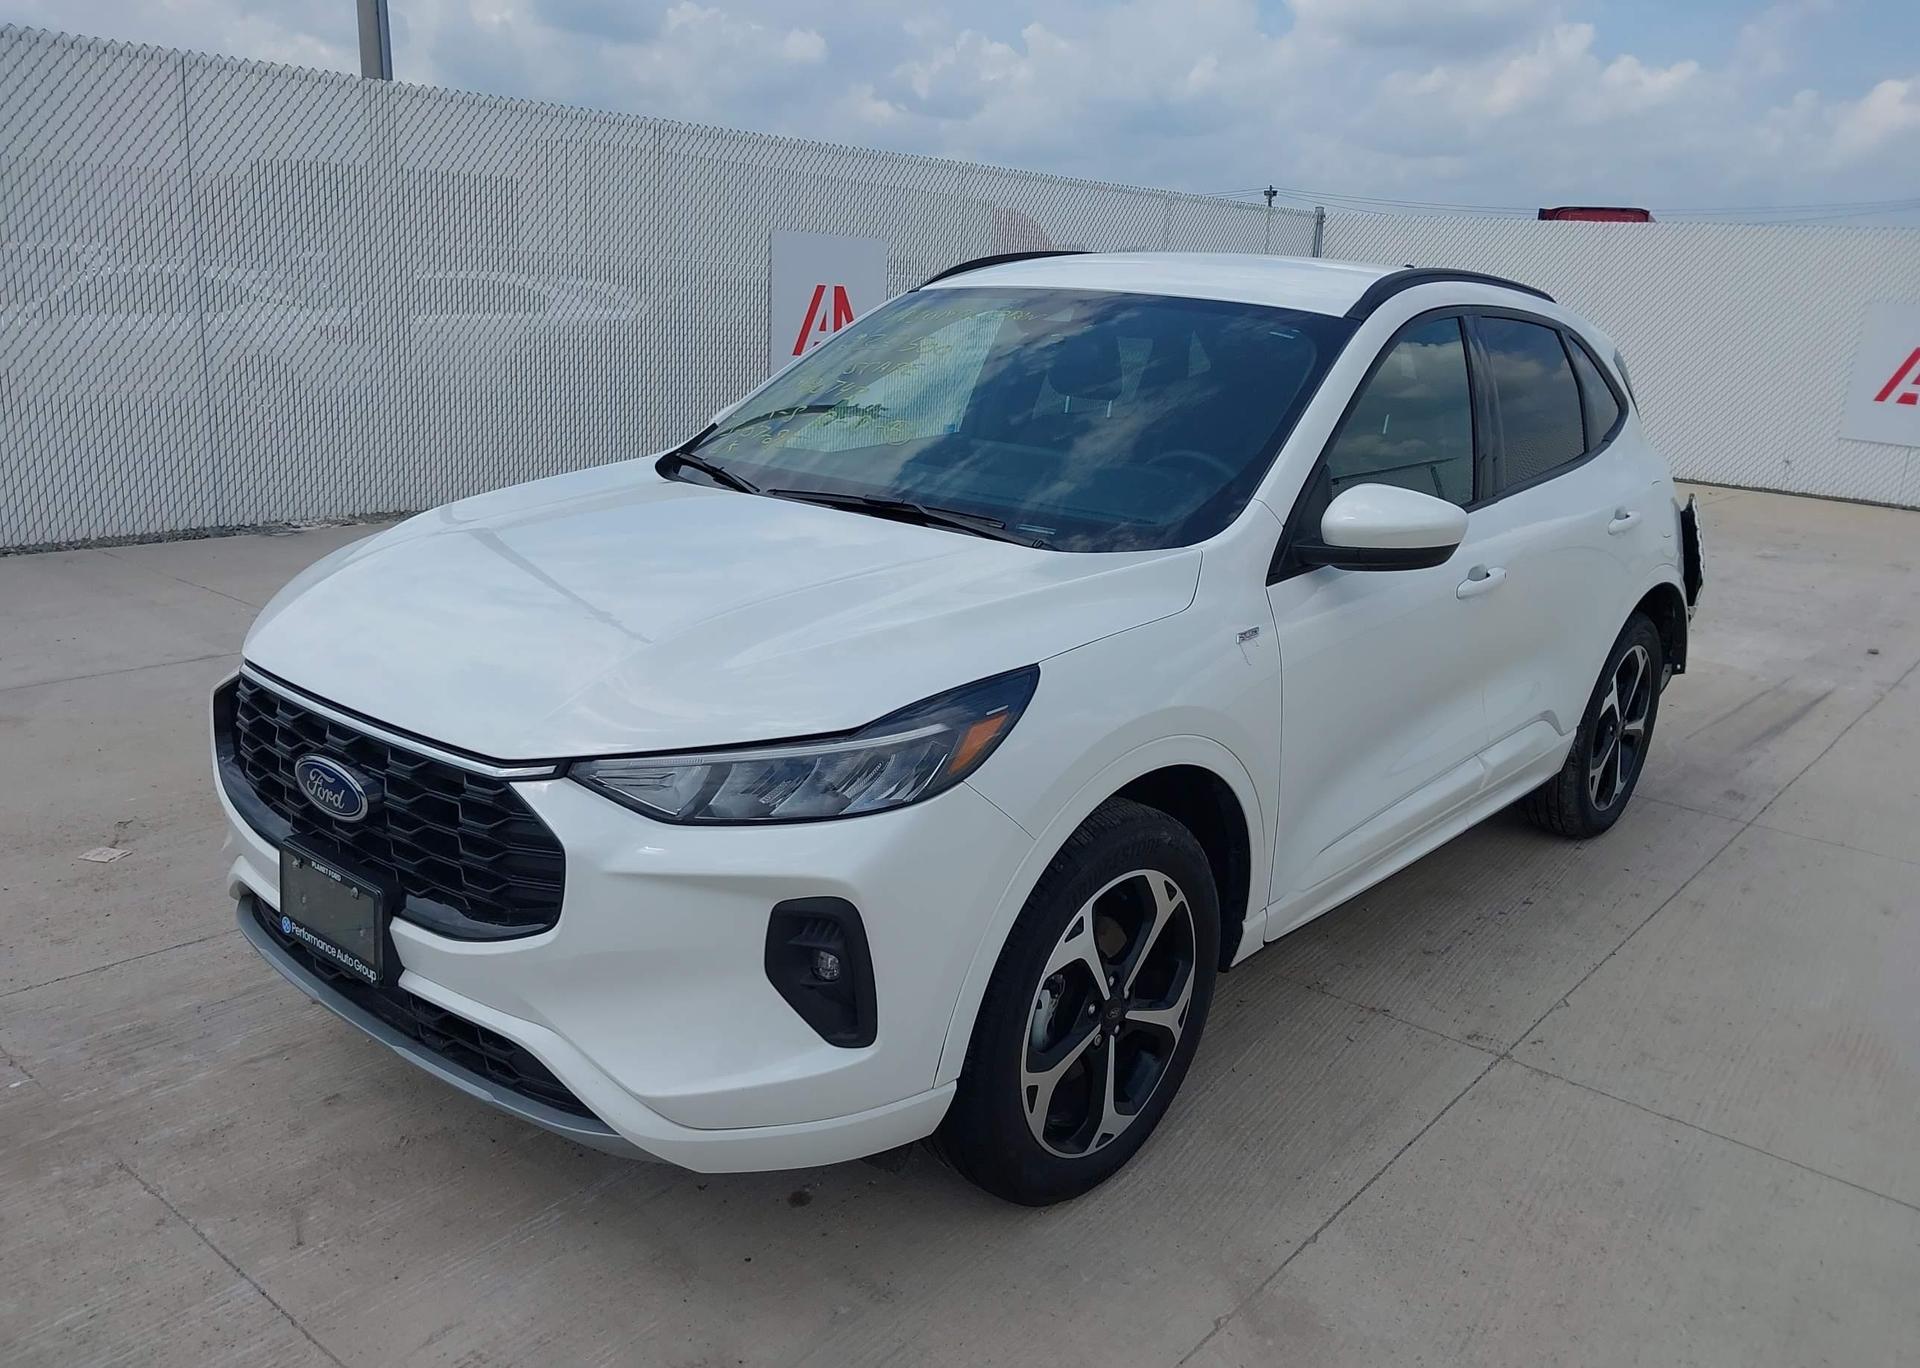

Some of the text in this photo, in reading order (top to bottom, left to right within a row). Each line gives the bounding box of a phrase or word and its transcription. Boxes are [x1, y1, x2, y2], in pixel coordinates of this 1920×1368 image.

[307, 768, 345, 809] Ford
[291, 921, 376, 983] Performance Auto Group
